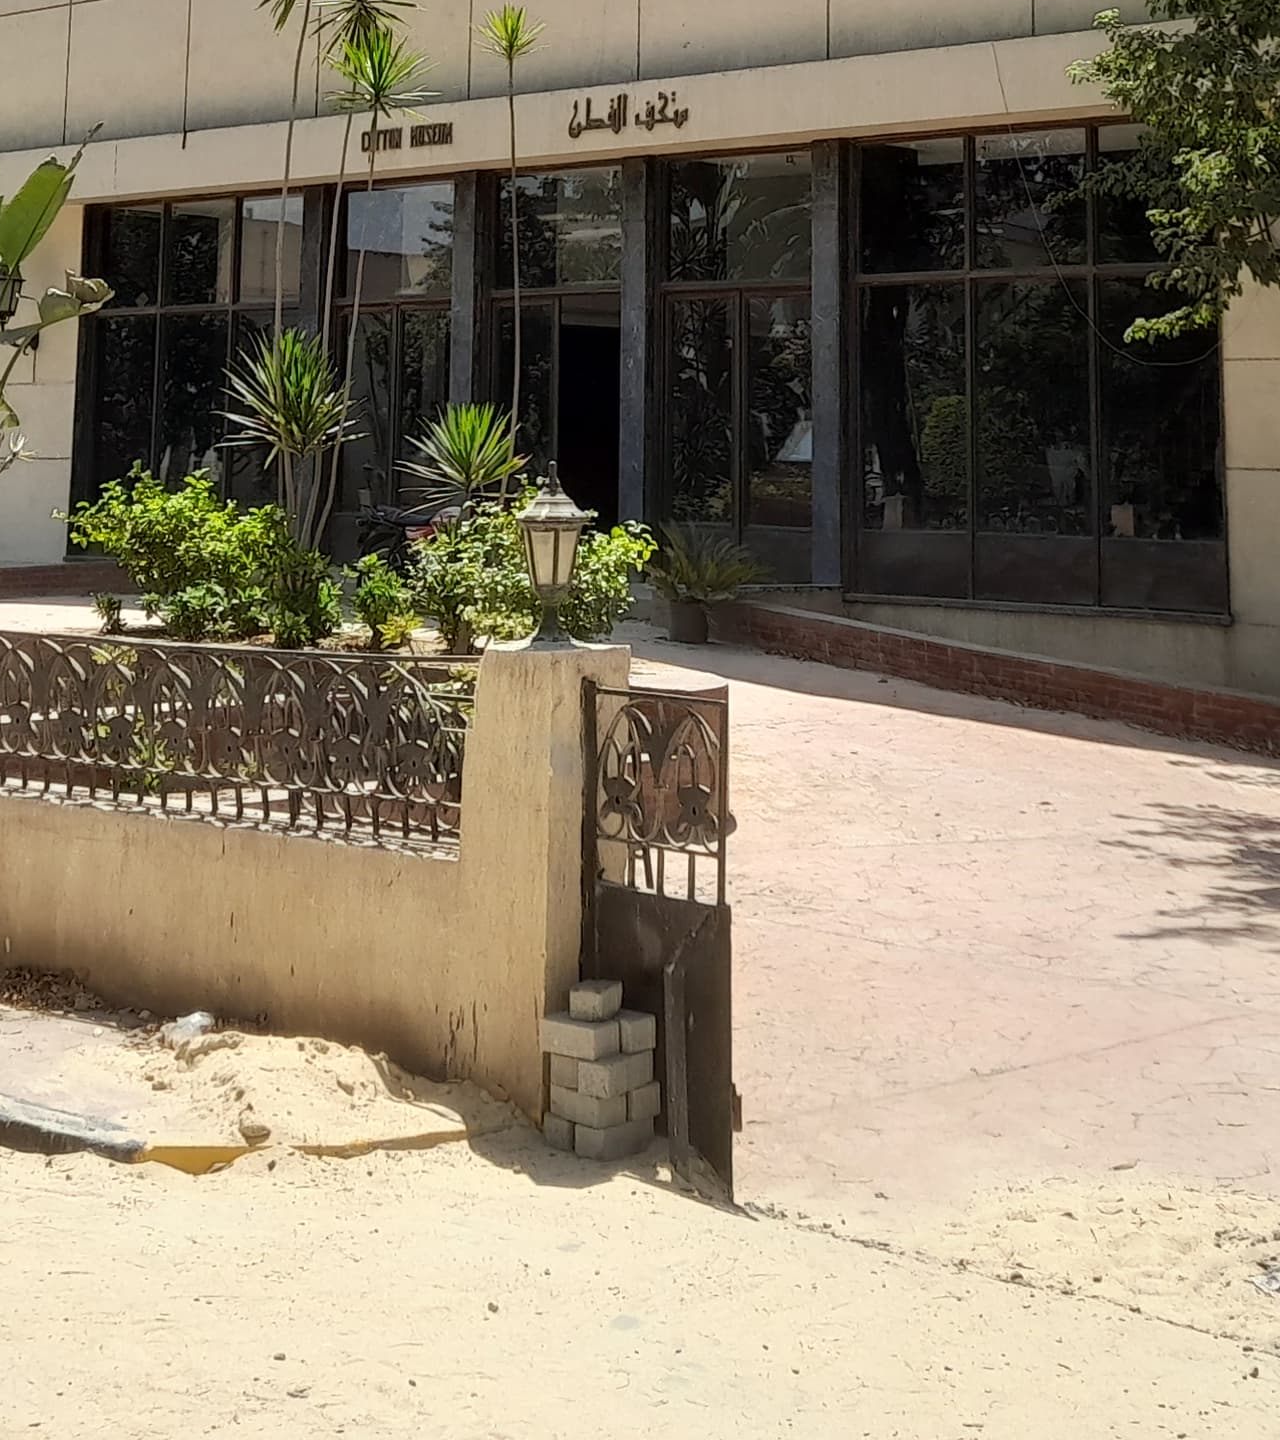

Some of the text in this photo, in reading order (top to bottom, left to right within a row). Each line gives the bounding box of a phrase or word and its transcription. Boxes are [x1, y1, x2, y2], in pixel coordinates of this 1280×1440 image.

[568, 91, 689, 139] متحف القطن
[410, 122, 453, 148] MUSEUM
